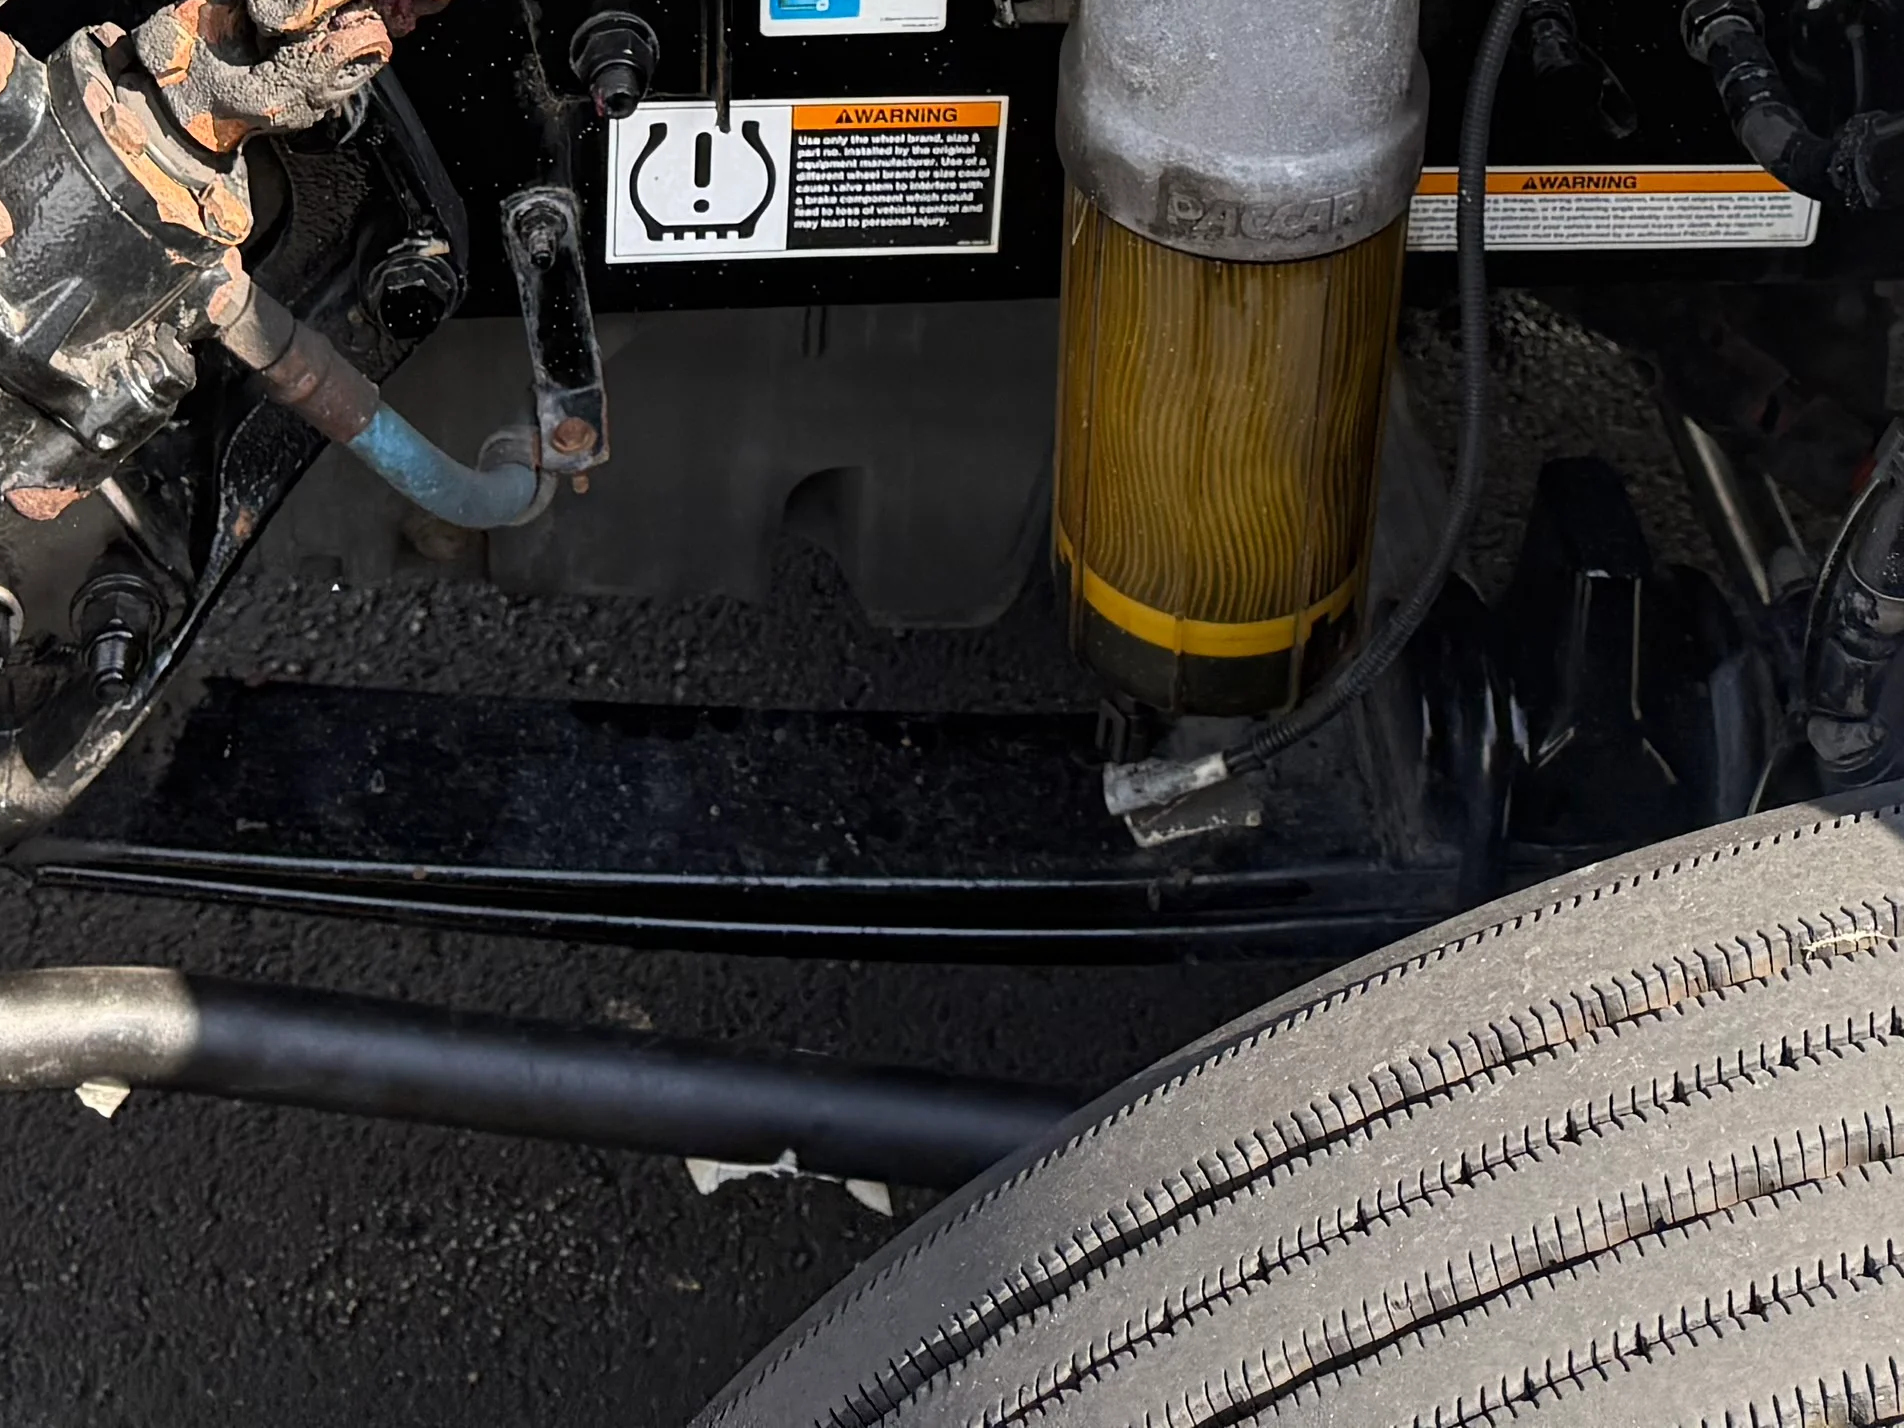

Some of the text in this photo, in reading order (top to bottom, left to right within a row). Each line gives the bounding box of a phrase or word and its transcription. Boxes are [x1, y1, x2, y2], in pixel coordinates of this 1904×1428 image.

[854, 108, 958, 123] WARNING
[798, 136, 820, 145] Use
[823, 135, 848, 146] only
[851, 136, 869, 144] the
[871, 134, 905, 144] wheel
[946, 134, 969, 142] size
[797, 148, 820, 158] part
[844, 146, 892, 156] installed
[895, 146, 909, 156] by
[912, 145, 930, 154] the
[932, 145, 975, 155] original
[796, 160, 857, 170] equipment
[941, 158, 963, 166] Use
[965, 157, 977, 166] of
[796, 168, 990, 181] different wheel brand or size could
[796, 184, 830, 193] cause
[865, 182, 893, 191] stem
[896, 182, 907, 191] to
[910, 181, 957, 190] interfere
[959, 181, 983, 189] with
[1540, 175, 1637, 190] WARNING
[795, 192, 974, 205] a brake component which could
[795, 204, 983, 217] lead to loss of vehicle control and
[1166, 189, 1367, 241] PACCAR
[794, 216, 949, 230] may lead to personal injury.
